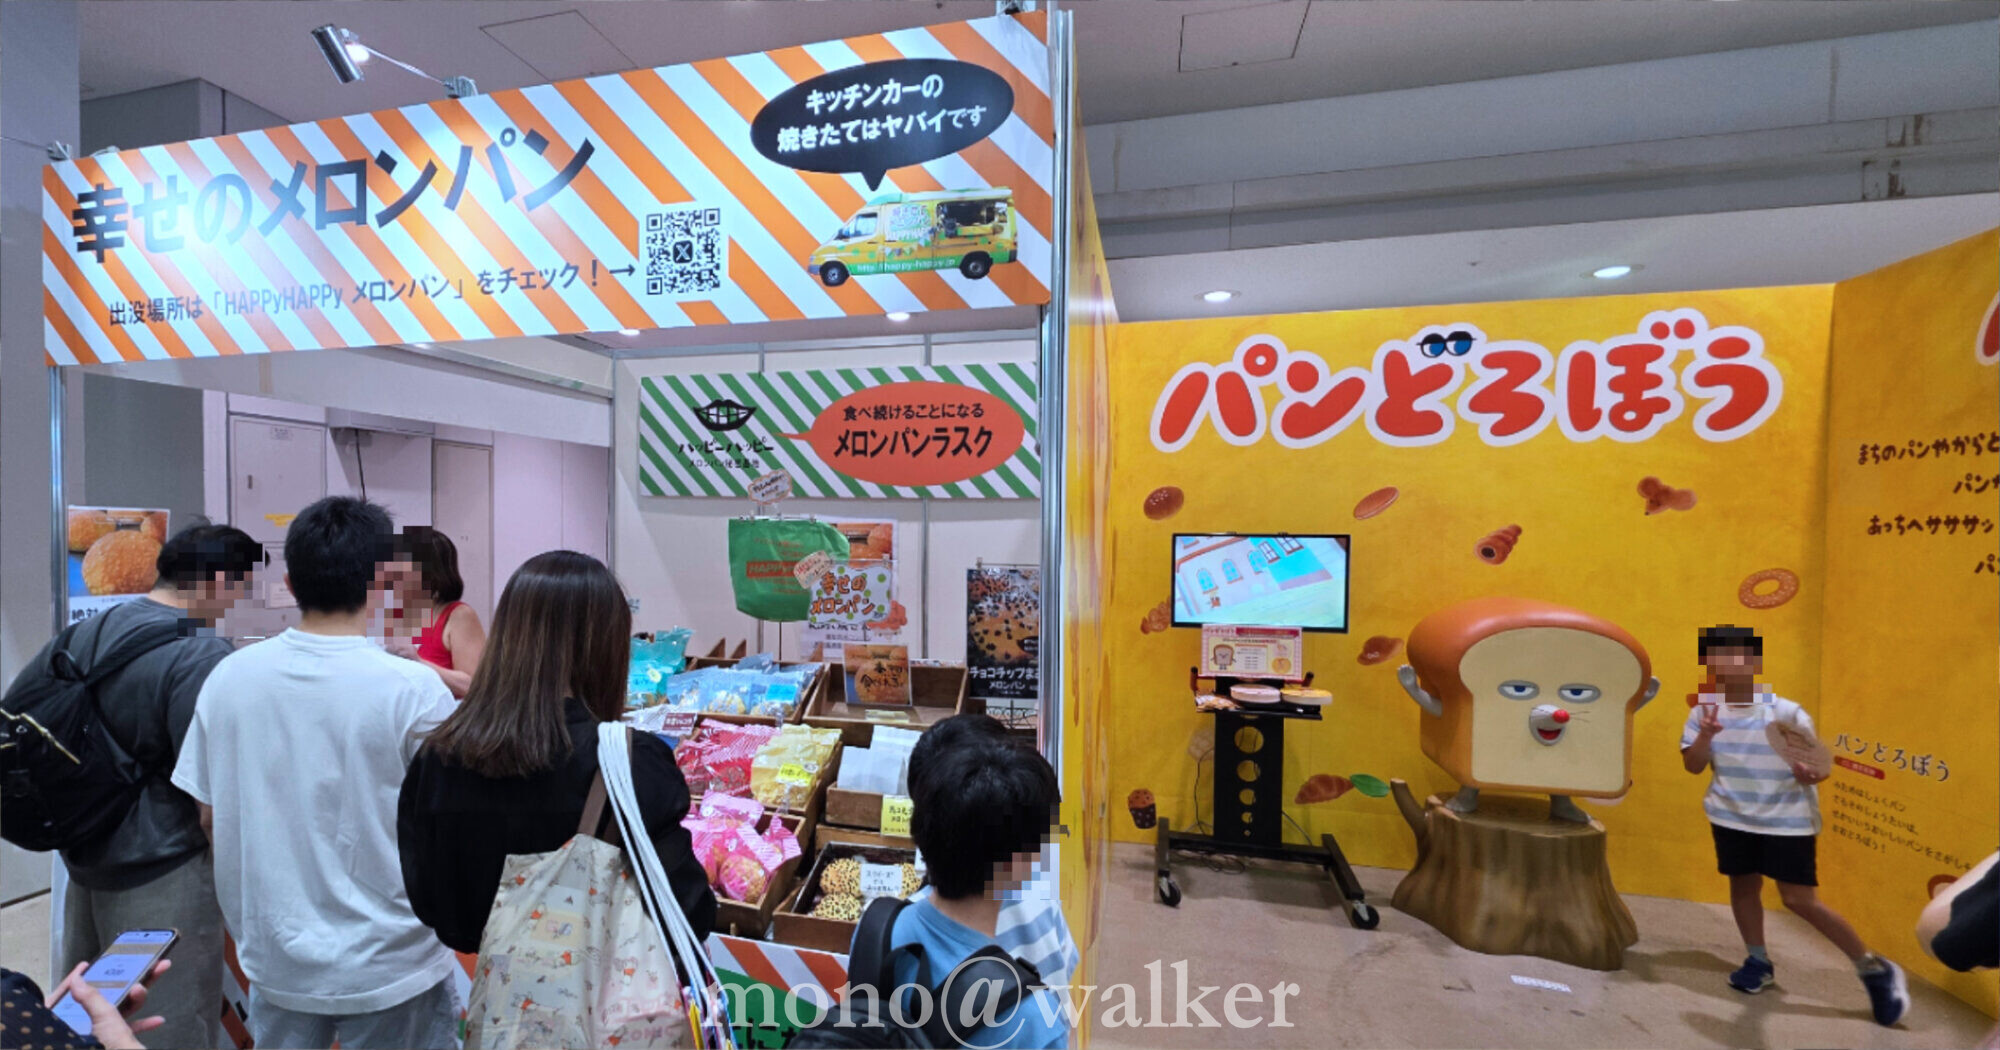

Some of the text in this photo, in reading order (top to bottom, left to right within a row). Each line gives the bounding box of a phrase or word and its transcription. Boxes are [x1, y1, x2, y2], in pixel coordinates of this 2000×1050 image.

[806, 74, 944, 115] キッチンカーの
[777, 105, 987, 152] 焼きたてはヤバイです
[72, 126, 595, 263] 幸せのメロンパン
[1155, 313, 1776, 448] パンどろぼう
[843, 403, 984, 422] 食べ続けることになる
[678, 436, 774, 455] ハッピーハッピー
[834, 426, 993, 459] メロンパンラスク
[820, 571, 867, 595] 幸せの
[810, 594, 875, 615] メロンパン
[989, 681, 1025, 691] メロンパン
[1834, 734, 1950, 781] パンどろぼう
